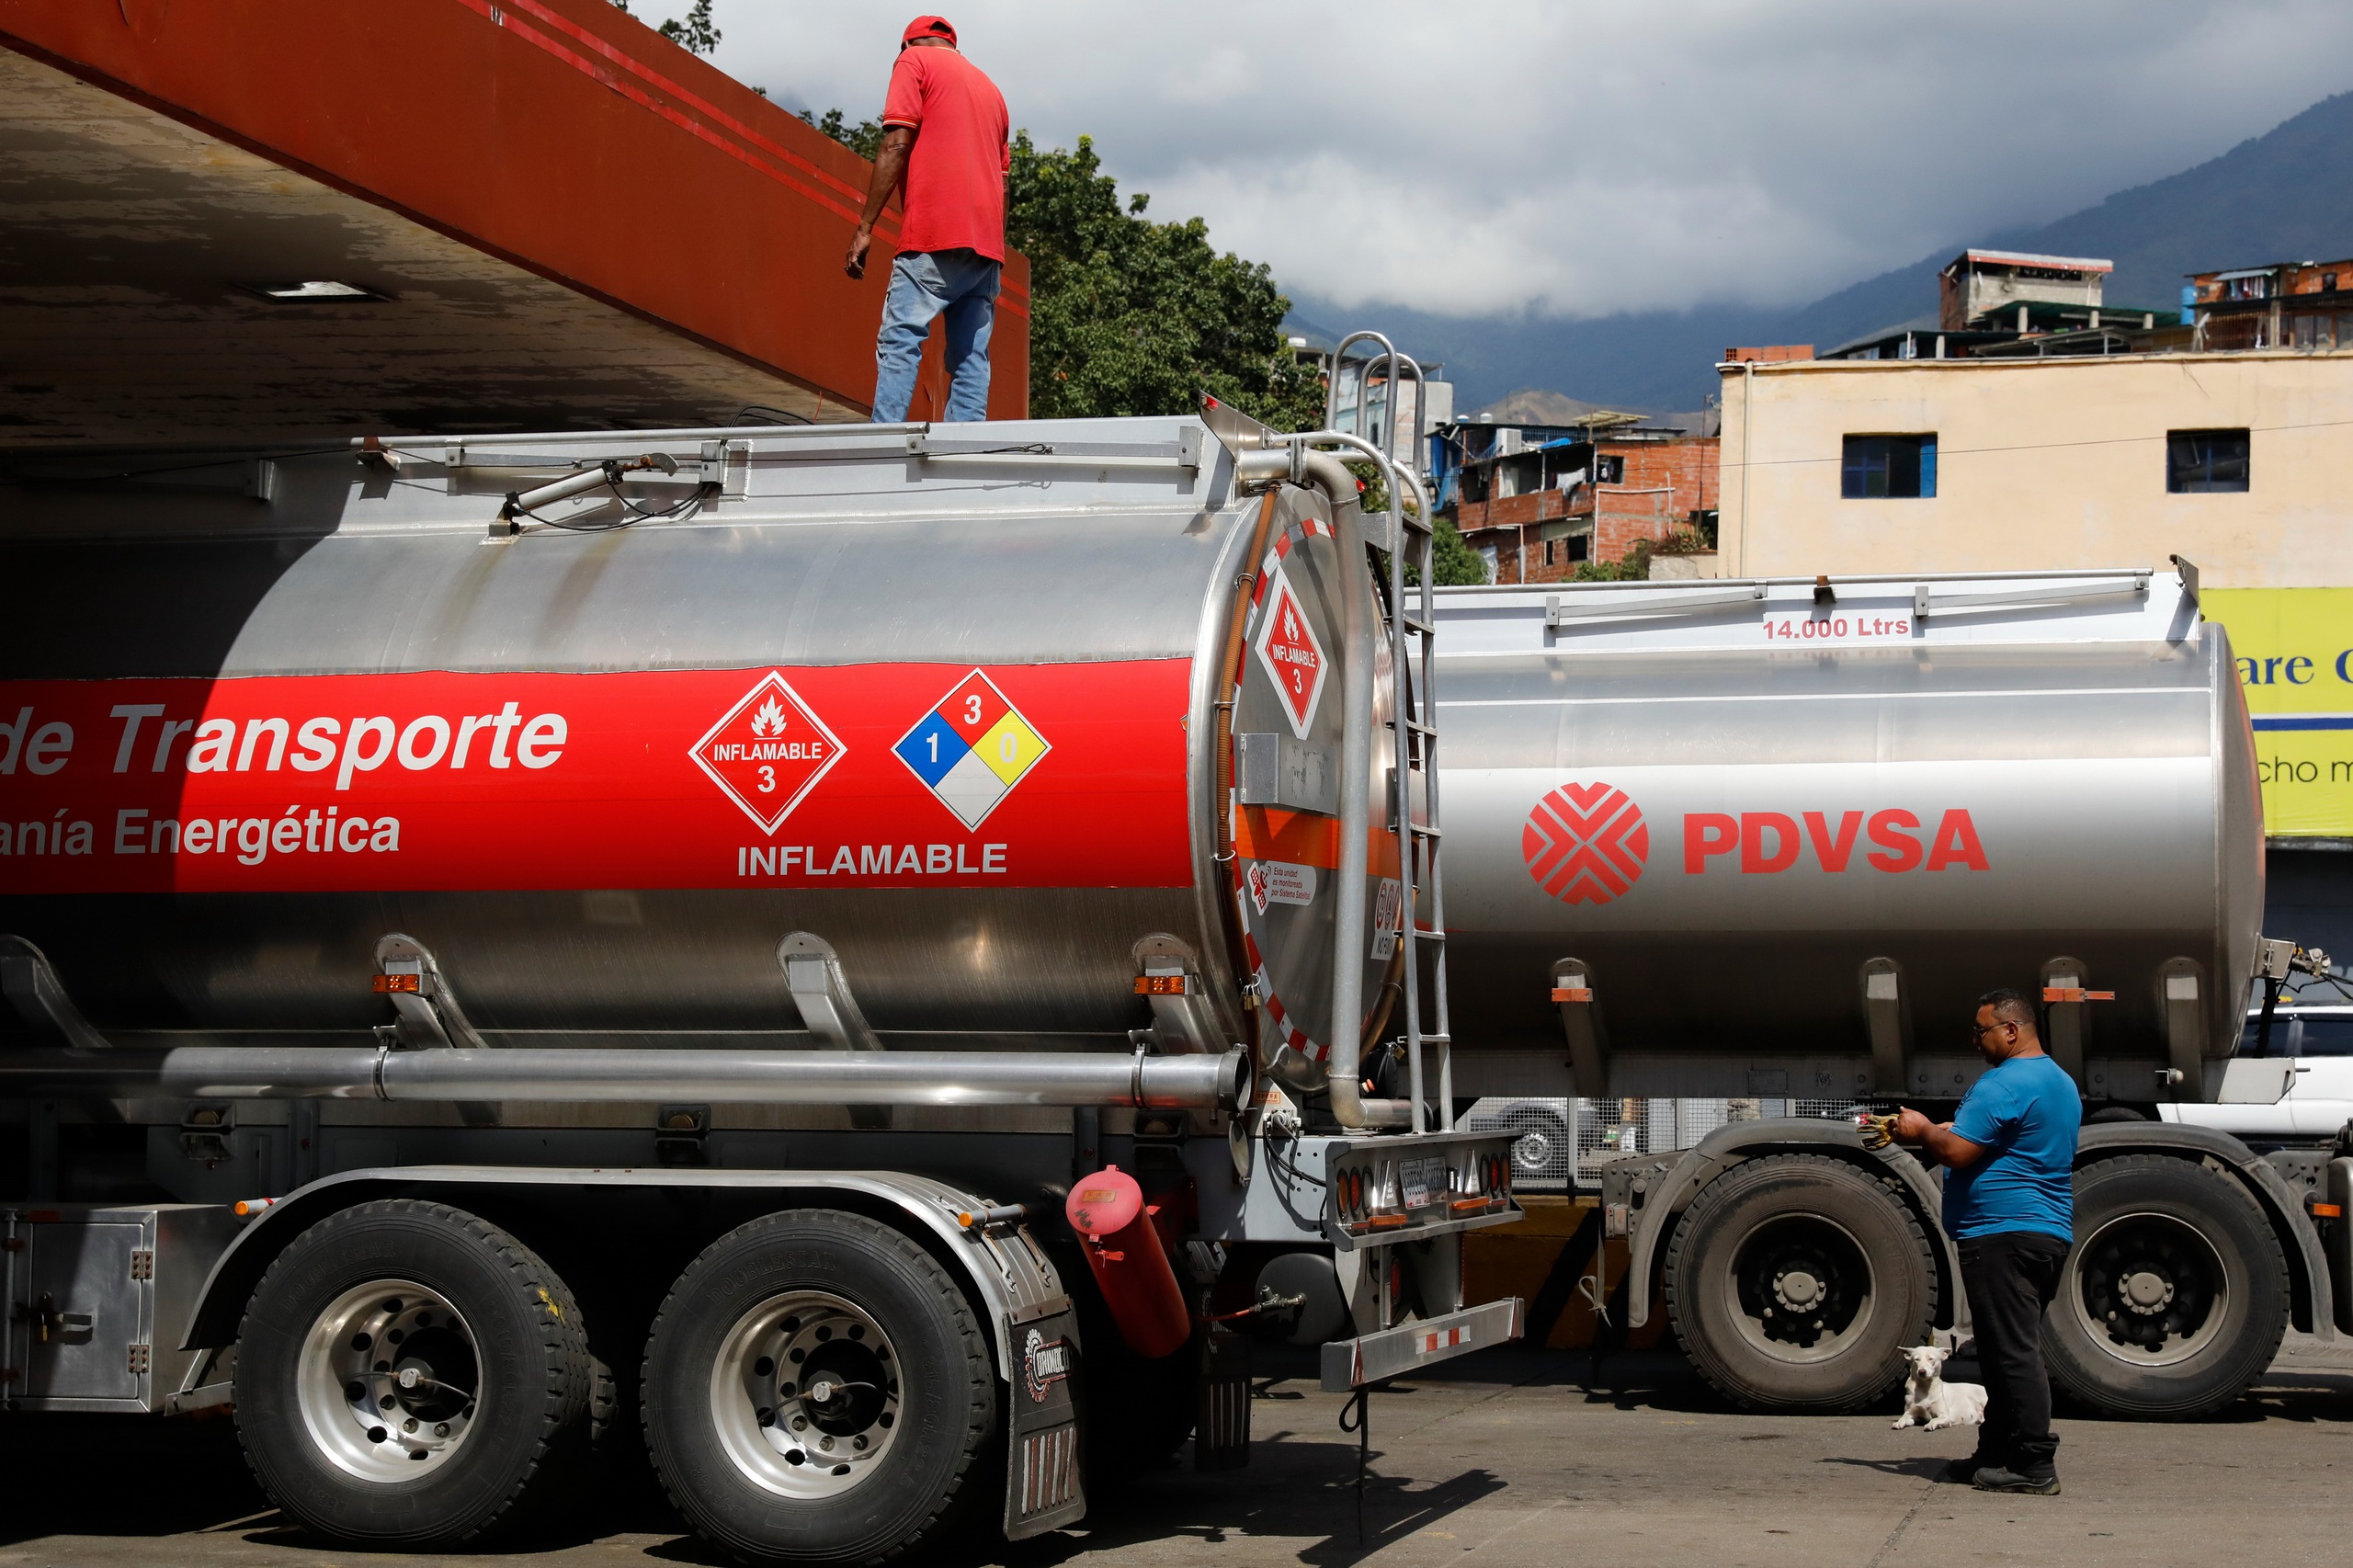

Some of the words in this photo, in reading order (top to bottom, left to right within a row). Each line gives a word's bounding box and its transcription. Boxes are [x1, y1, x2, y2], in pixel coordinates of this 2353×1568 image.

[1762, 618, 1848, 640] 14.000
[1857, 617, 1910, 637] Ltrs
[1271, 643, 1316, 668] INFLAMABLE
[1292, 667, 1302, 695] 3
[963, 694, 983, 725] 3
[0, 706, 74, 776] de
[108, 701, 569, 790] Transporte
[713, 742, 823, 762] INFLAMABLE
[926, 733, 939, 763] 1
[999, 732, 1017, 763] 0
[756, 765, 777, 793] 3
[114, 805, 401, 865] Energética
[1683, 808, 1992, 874] PDVSA
[737, 843, 1008, 877] INFLAMABLE
[705, 1250, 836, 1309] DOUBLESTAR
[1035, 1341, 1071, 1378] ORINOCO
